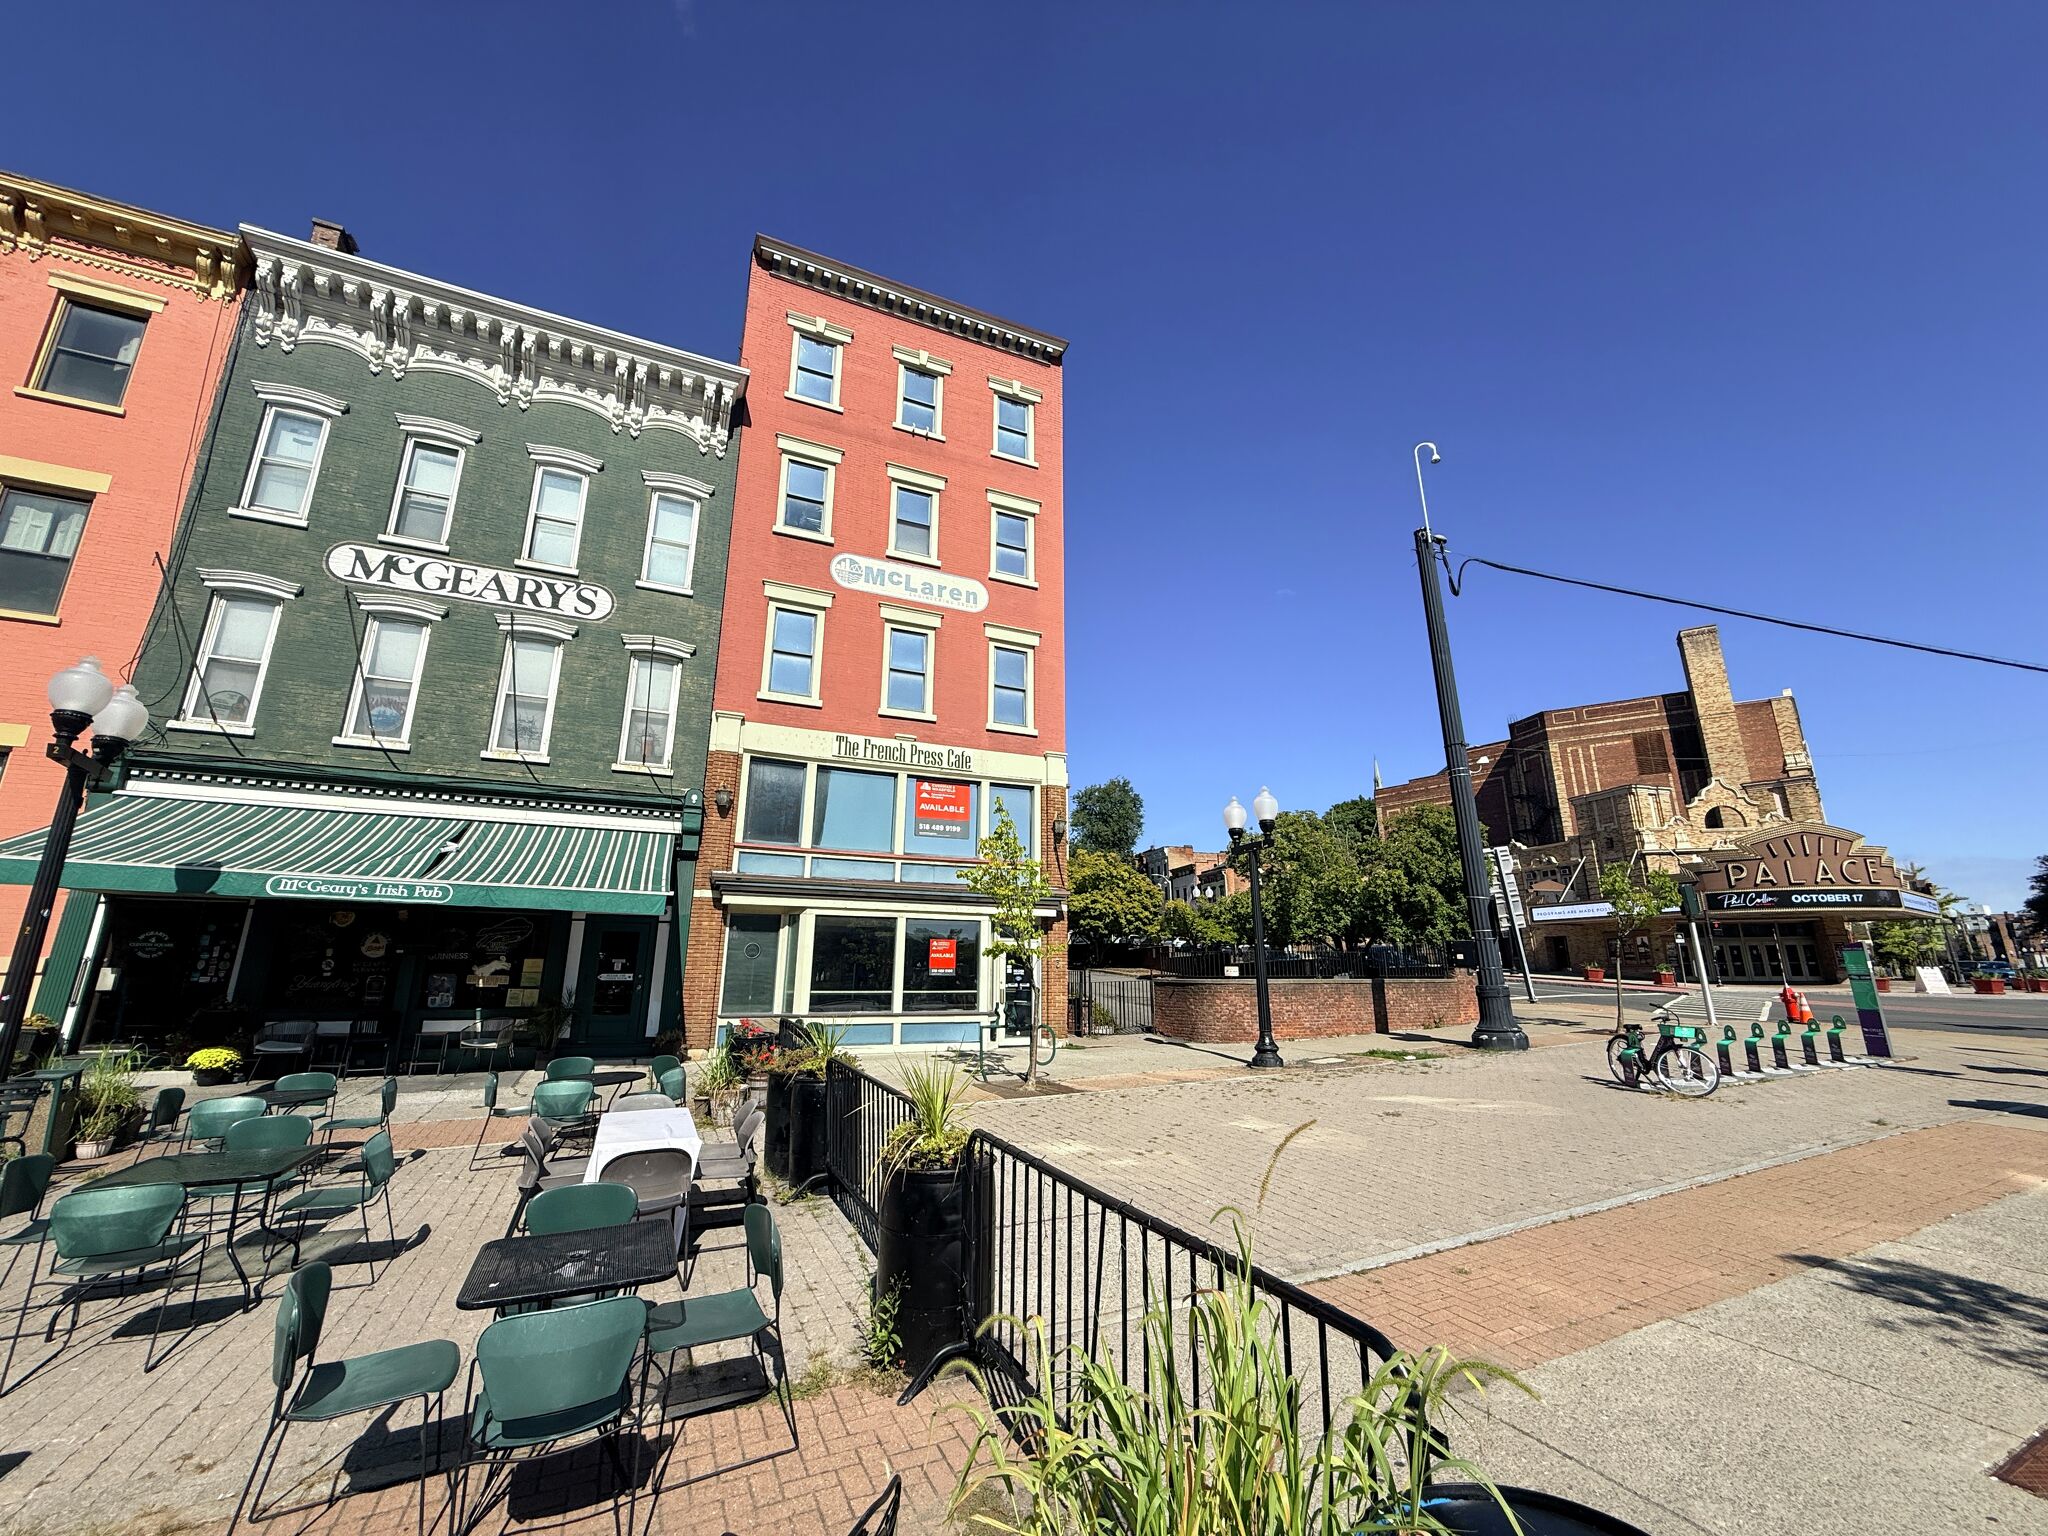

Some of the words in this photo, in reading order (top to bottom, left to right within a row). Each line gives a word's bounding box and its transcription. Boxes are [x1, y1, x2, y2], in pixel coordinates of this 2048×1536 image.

[343, 547, 598, 616] McGEARY'S
[863, 565, 978, 605] McLaren
[53, 746, 59, 754] 2
[836, 735, 859, 756] The
[863, 738, 906, 762] French
[910, 744, 944, 766] Press
[947, 749, 972, 770] Cafe
[919, 803, 965, 814] AVAILABLE
[1725, 857, 1882, 888] PALACE
[277, 878, 369, 898] McGeary's
[374, 884, 408, 897] Irish
[414, 885, 443, 898] Pub
[1717, 893, 1745, 908] Phil
[1791, 894, 1851, 903] OCTOBER
[1852, 893, 1864, 903] 17
[24, 926, 31, 935] 2
